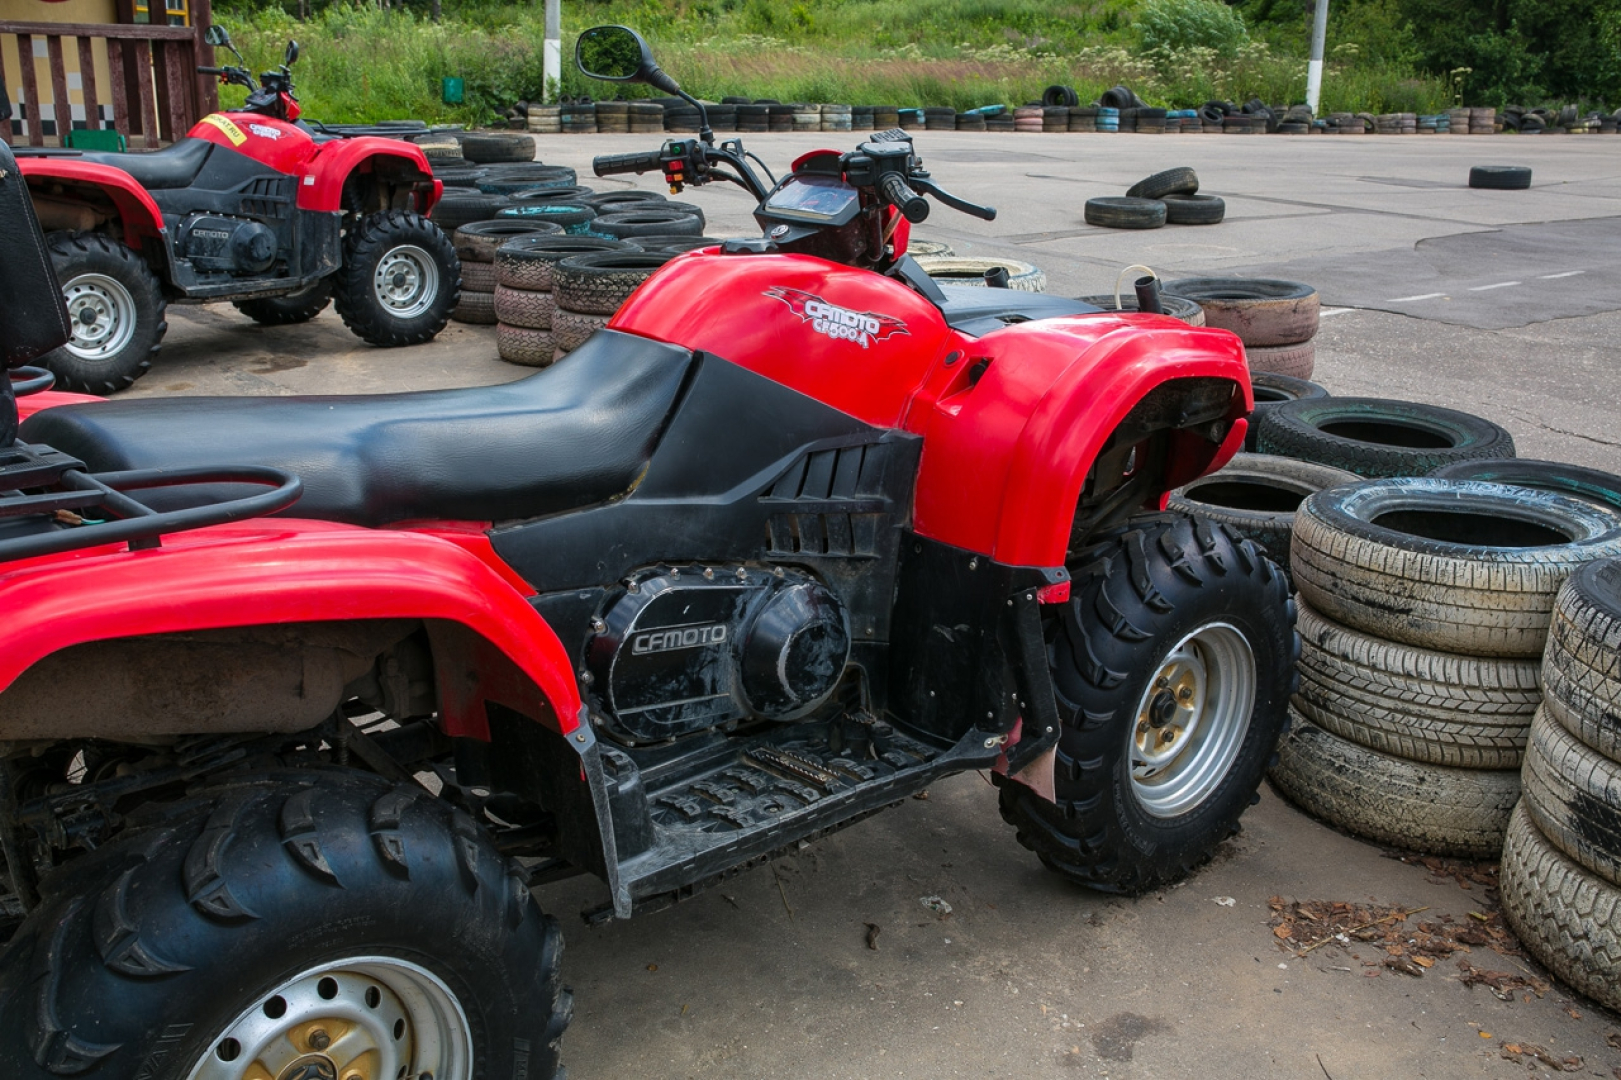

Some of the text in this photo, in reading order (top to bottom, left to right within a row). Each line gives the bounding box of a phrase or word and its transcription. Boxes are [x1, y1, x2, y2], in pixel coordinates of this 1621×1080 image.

[193, 229, 229, 239] CFMOTO
[805, 300, 880, 335] CFMOTO
[633, 624, 727, 652] CFMOTO
